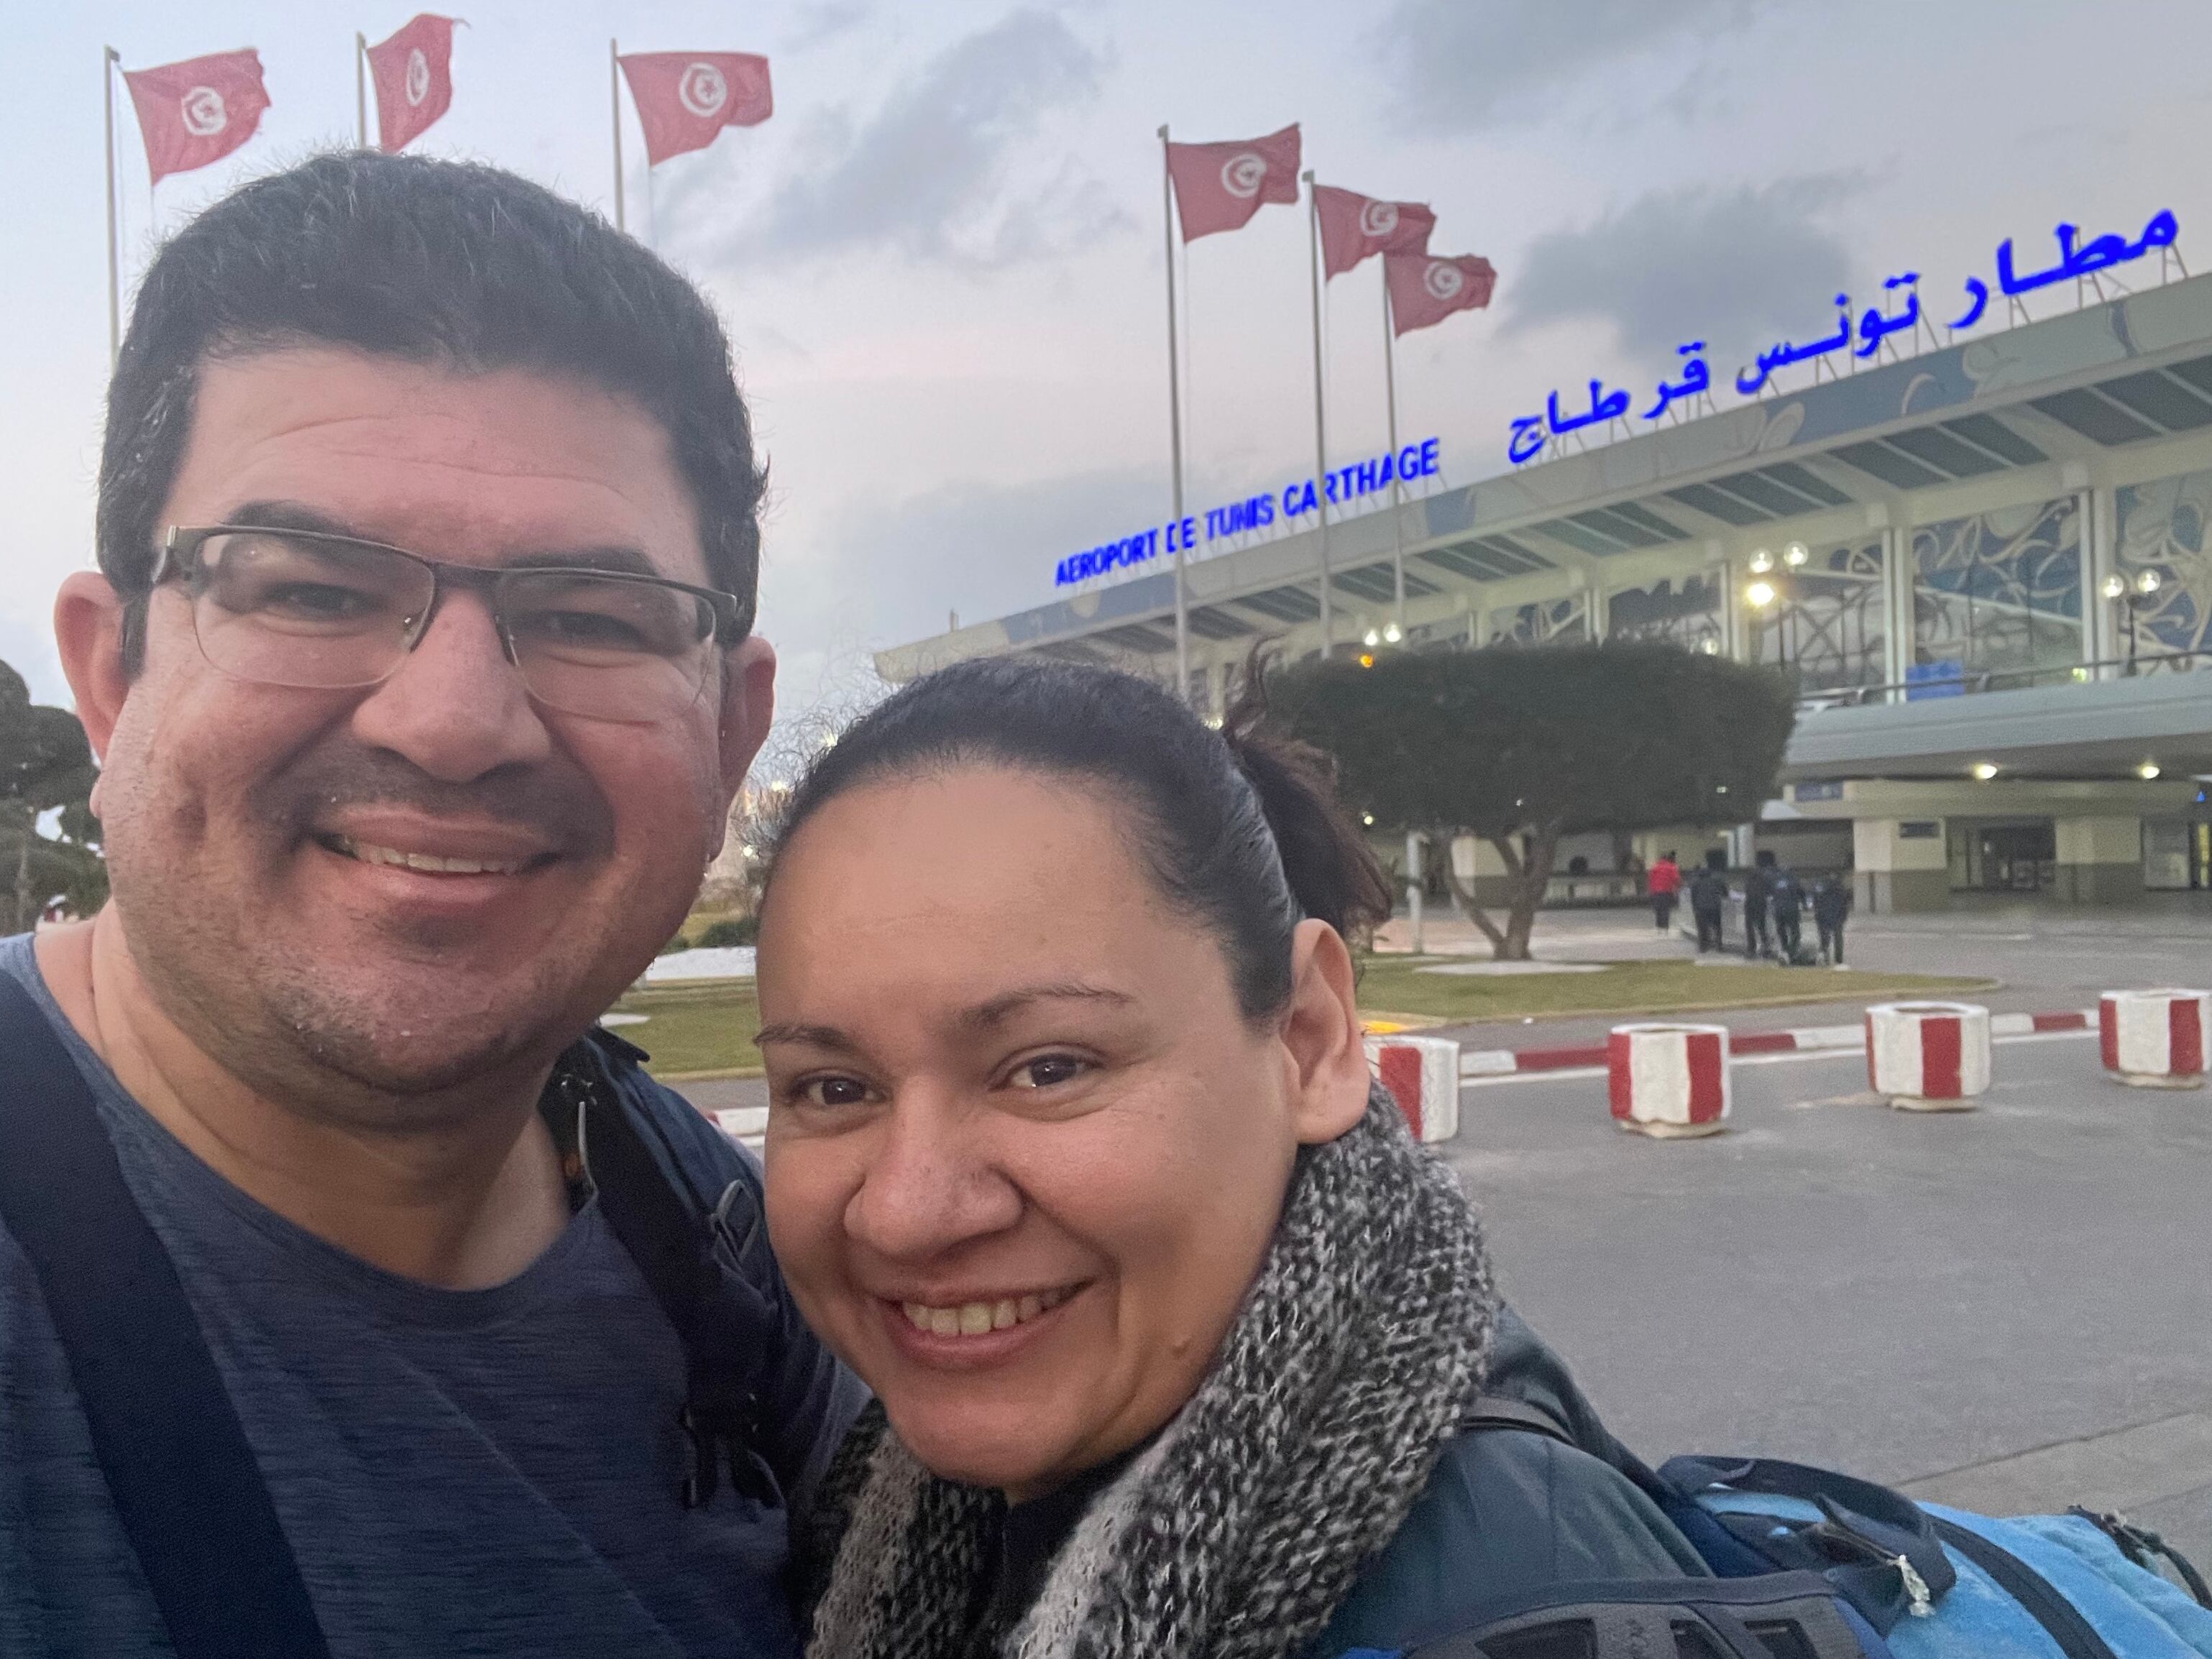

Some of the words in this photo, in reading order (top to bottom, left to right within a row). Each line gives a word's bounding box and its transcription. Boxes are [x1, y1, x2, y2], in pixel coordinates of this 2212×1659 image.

[1946, 207, 2180, 331] مطار
[1734, 270, 1921, 397] تونس
[1505, 339, 1710, 467] قرطاج
[1053, 526, 1159, 587] AEROPORT
[1203, 492, 1275, 541] TUNIS
[1280, 436, 1439, 518] CARTHAGE
